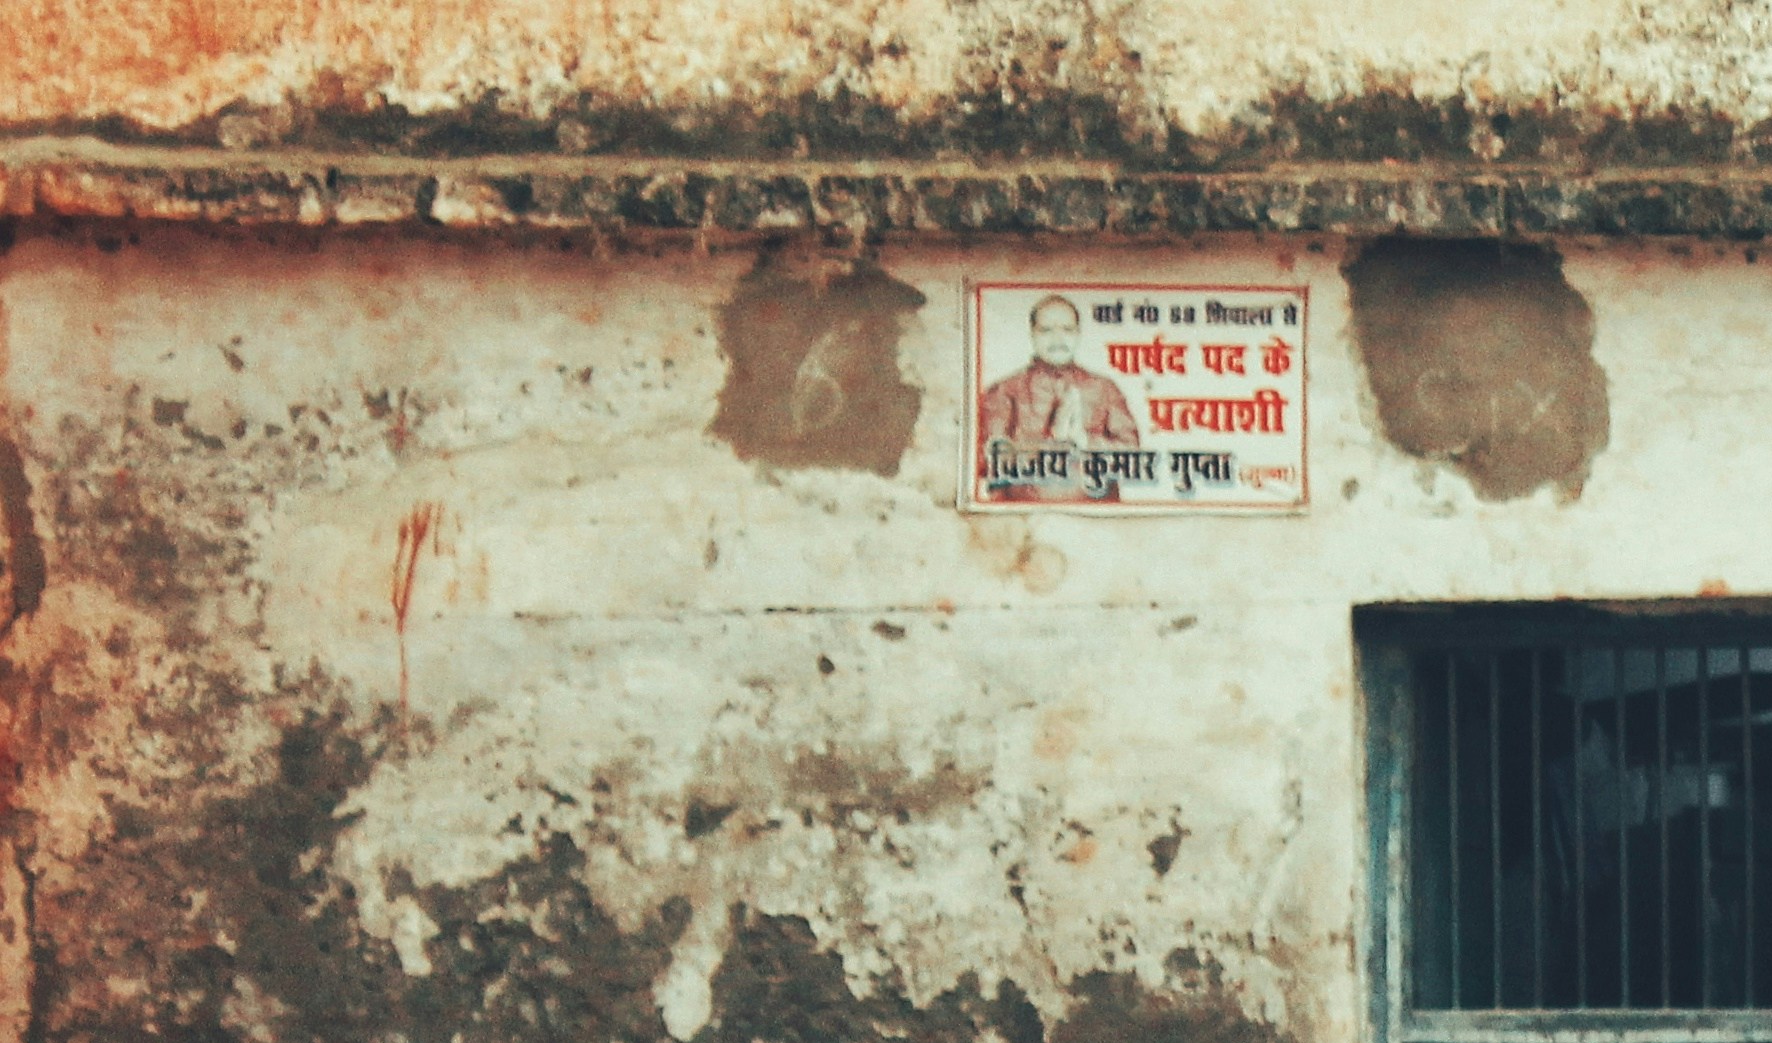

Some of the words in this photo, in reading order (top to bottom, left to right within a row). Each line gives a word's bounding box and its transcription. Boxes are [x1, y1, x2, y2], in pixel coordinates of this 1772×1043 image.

[1107, 335, 1187, 375] पार्षद
[1201, 345, 1247, 375] पद
[1260, 334, 1293, 375] के
[1147, 388, 1288, 432] प्रत्याशी
[989, 440, 1071, 479] विजय
[1081, 449, 1157, 492] कुमार
[1168, 451, 1233, 492] गुप्ता
